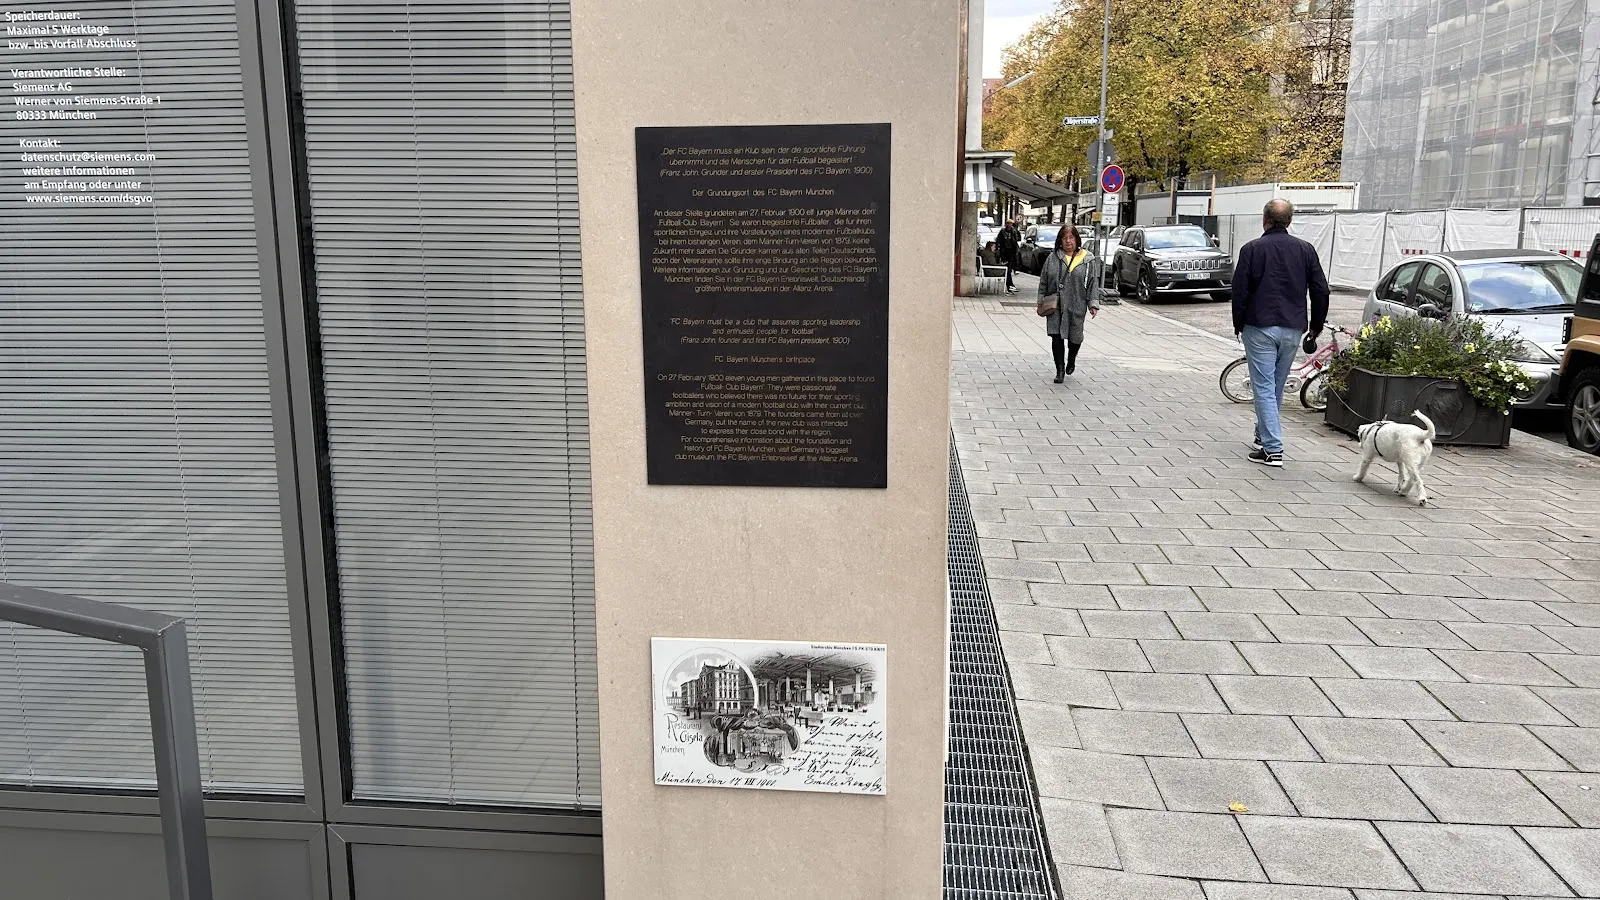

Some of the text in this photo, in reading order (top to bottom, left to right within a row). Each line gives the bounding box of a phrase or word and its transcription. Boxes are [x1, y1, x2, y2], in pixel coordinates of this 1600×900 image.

[5, 11, 80, 22] Speicherdauer:
[7, 25, 110, 36] Maximal 5 Werktage
[8, 38, 137, 49] bzw. bis Vorfall-Abschluss
[11, 66, 126, 78] Verantwortliche Stelle:
[13, 82, 72, 92] Siemens AG
[14, 96, 51, 106] Werner
[75, 95, 153, 105] Siemens-Straße
[156, 96, 161, 104] 1
[16, 109, 97, 120] 80333 München
[19, 139, 61, 148] Kontakt:
[689, 147, 712, 156] Bayern
[803, 146, 836, 154] sportliche
[21, 151, 156, 162] datenschutz@siemens.com
[23, 165, 135, 175] weitere Informationen
[24, 180, 142, 191] am Empfang oder unter
[779, 189, 802, 197] Bayern
[26, 194, 153, 205] www.siemens.com/dsgvo
[762, 218, 800, 226] begeisterte
[853, 266, 878, 274] Bayern
[682, 318, 705, 326] Bayern
[802, 318, 827, 326] sporting
[829, 319, 861, 327] leadership
[778, 337, 800, 345] Bayern
[693, 436, 739, 444] comprehensive
[680, 731, 703, 744] Gisela
